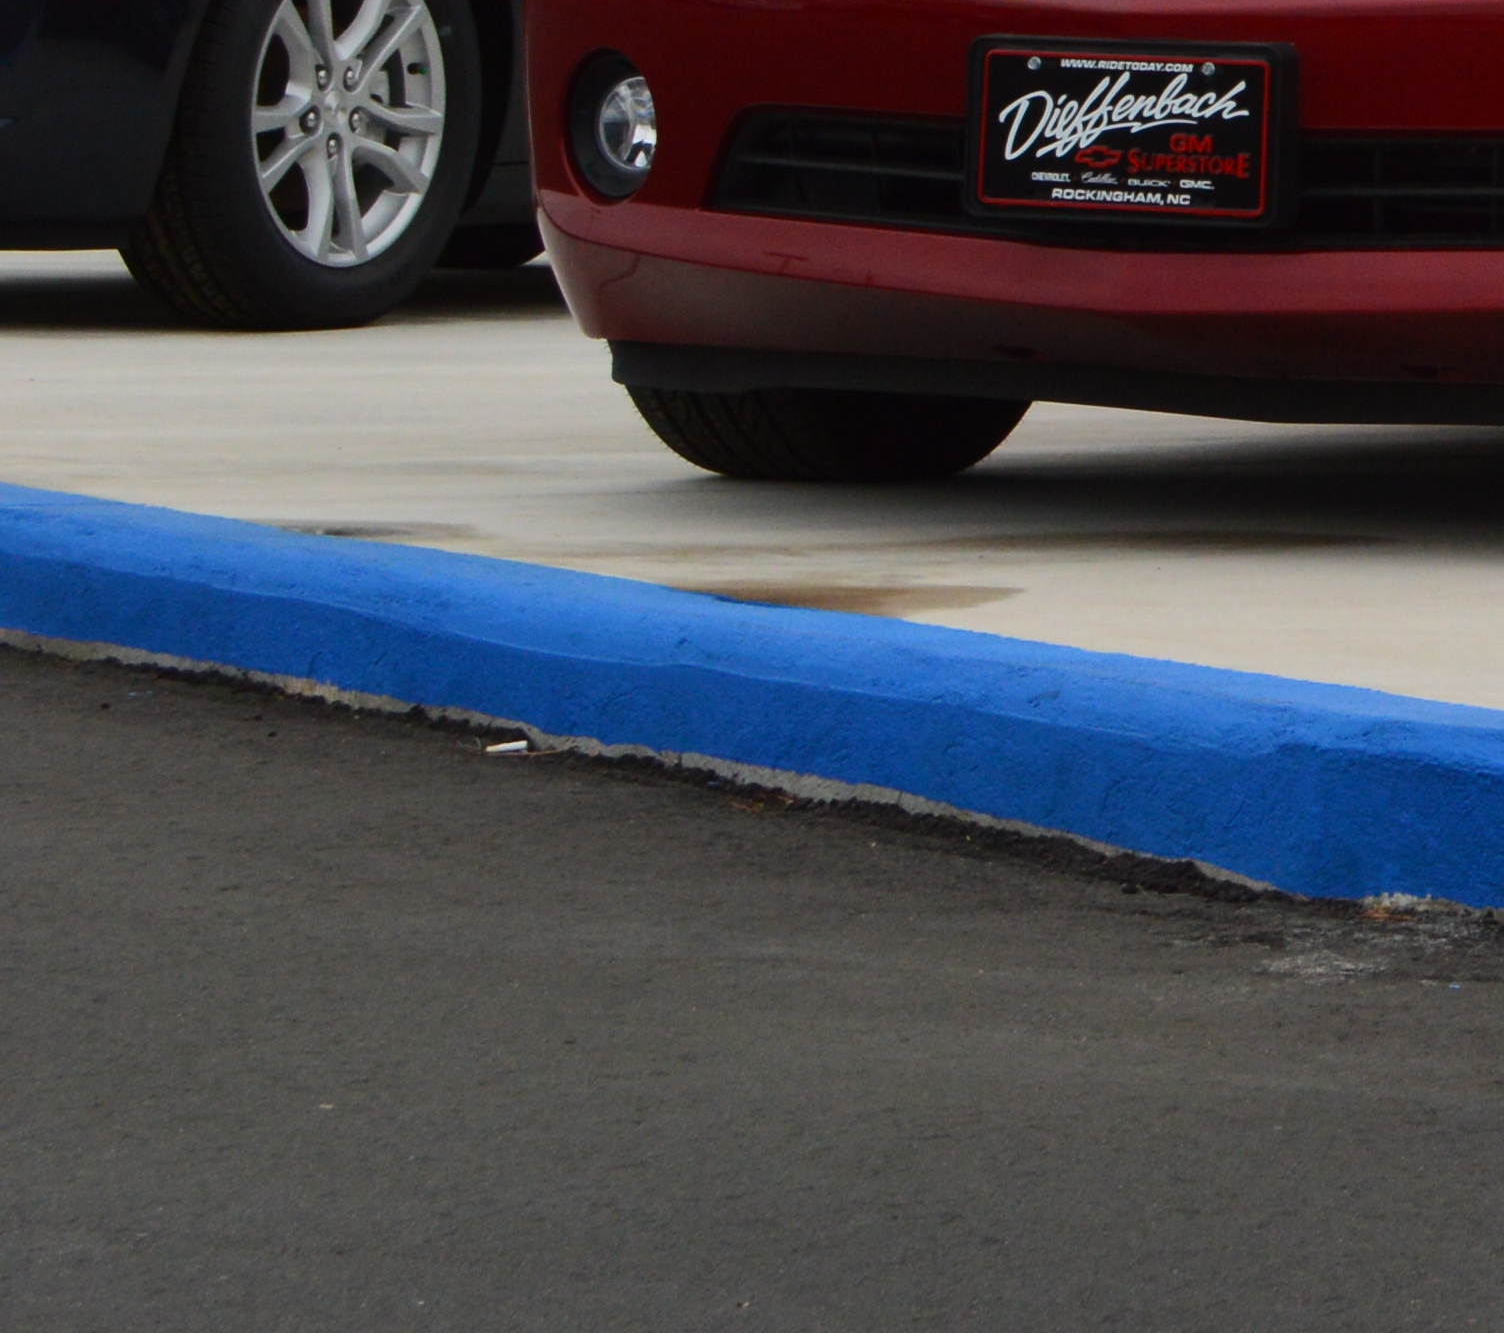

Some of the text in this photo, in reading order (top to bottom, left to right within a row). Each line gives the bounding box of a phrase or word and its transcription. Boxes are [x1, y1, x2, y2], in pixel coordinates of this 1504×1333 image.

[1060, 58, 1194, 73] WWW.RIDETODAY.COM
[999, 71, 1249, 161] Dieffenbach
[1168, 133, 1213, 153] GM
[1127, 178, 1170, 188] BUICK
[1179, 179, 1214, 190] GMC
[1051, 188, 1191, 206] ROCKINGHAM, NC
